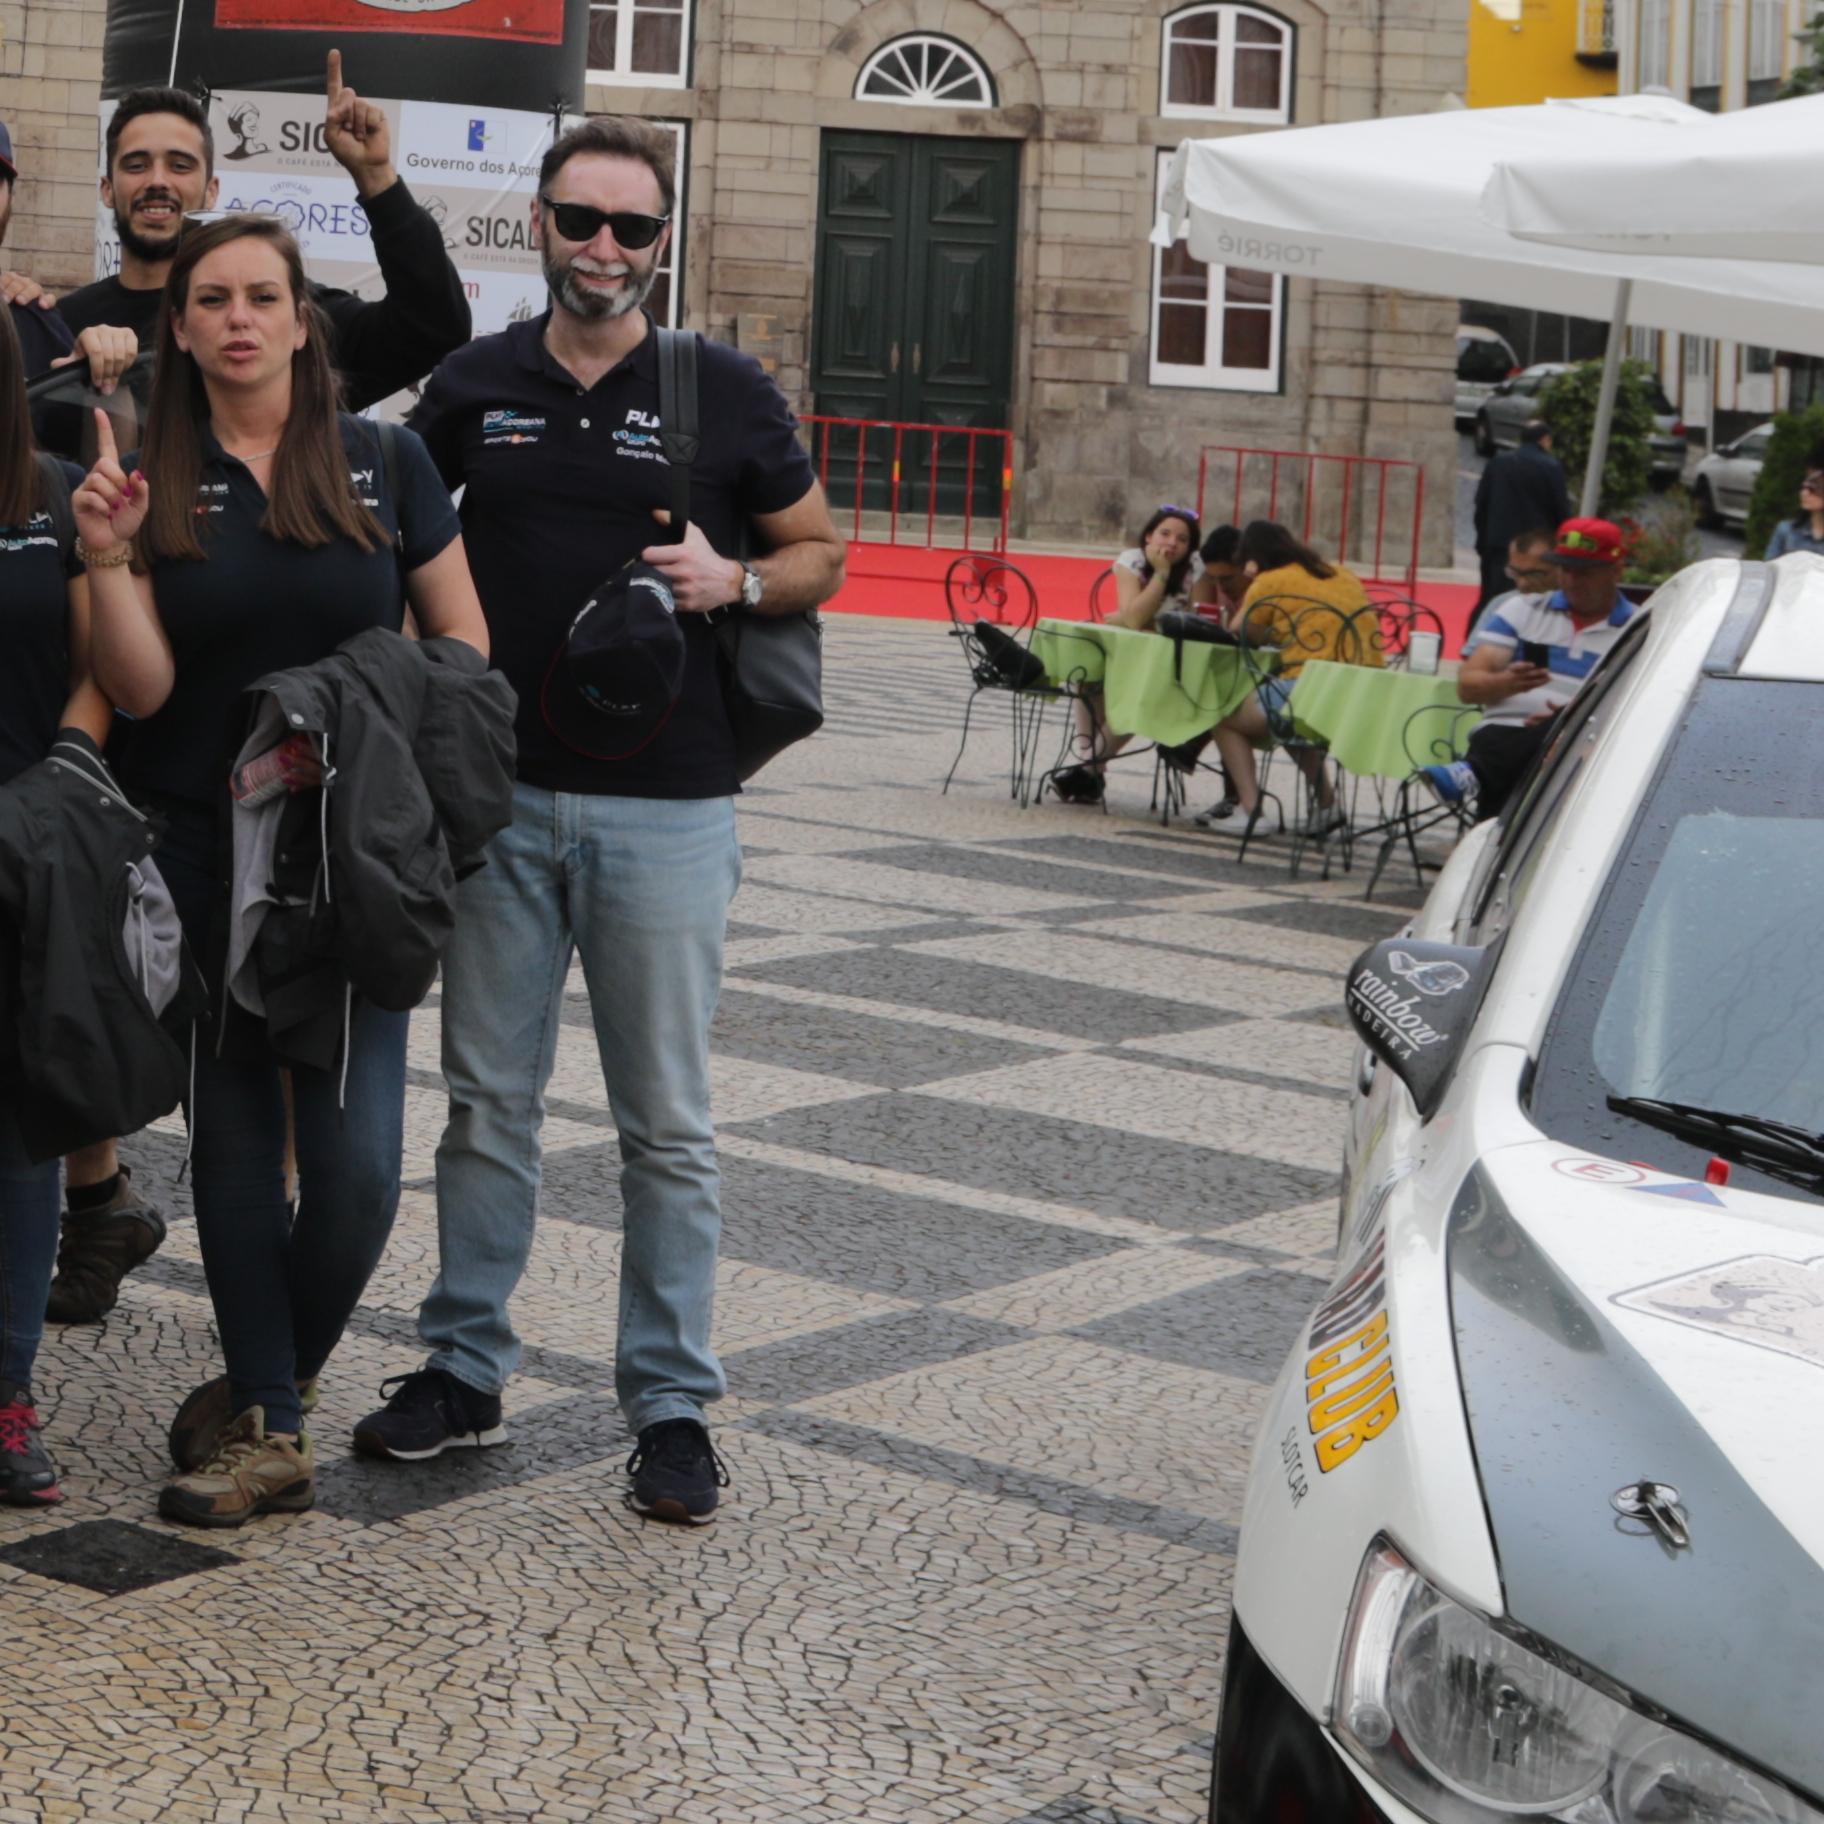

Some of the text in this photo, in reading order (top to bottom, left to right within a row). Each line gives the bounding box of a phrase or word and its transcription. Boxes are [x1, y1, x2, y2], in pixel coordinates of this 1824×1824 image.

[278, 120, 331, 154] SIC
[406, 152, 542, 178] Governo dos Açore
[1353, 968, 1442, 1046] rainbow
[1304, 1307, 1400, 1475] CLUB
